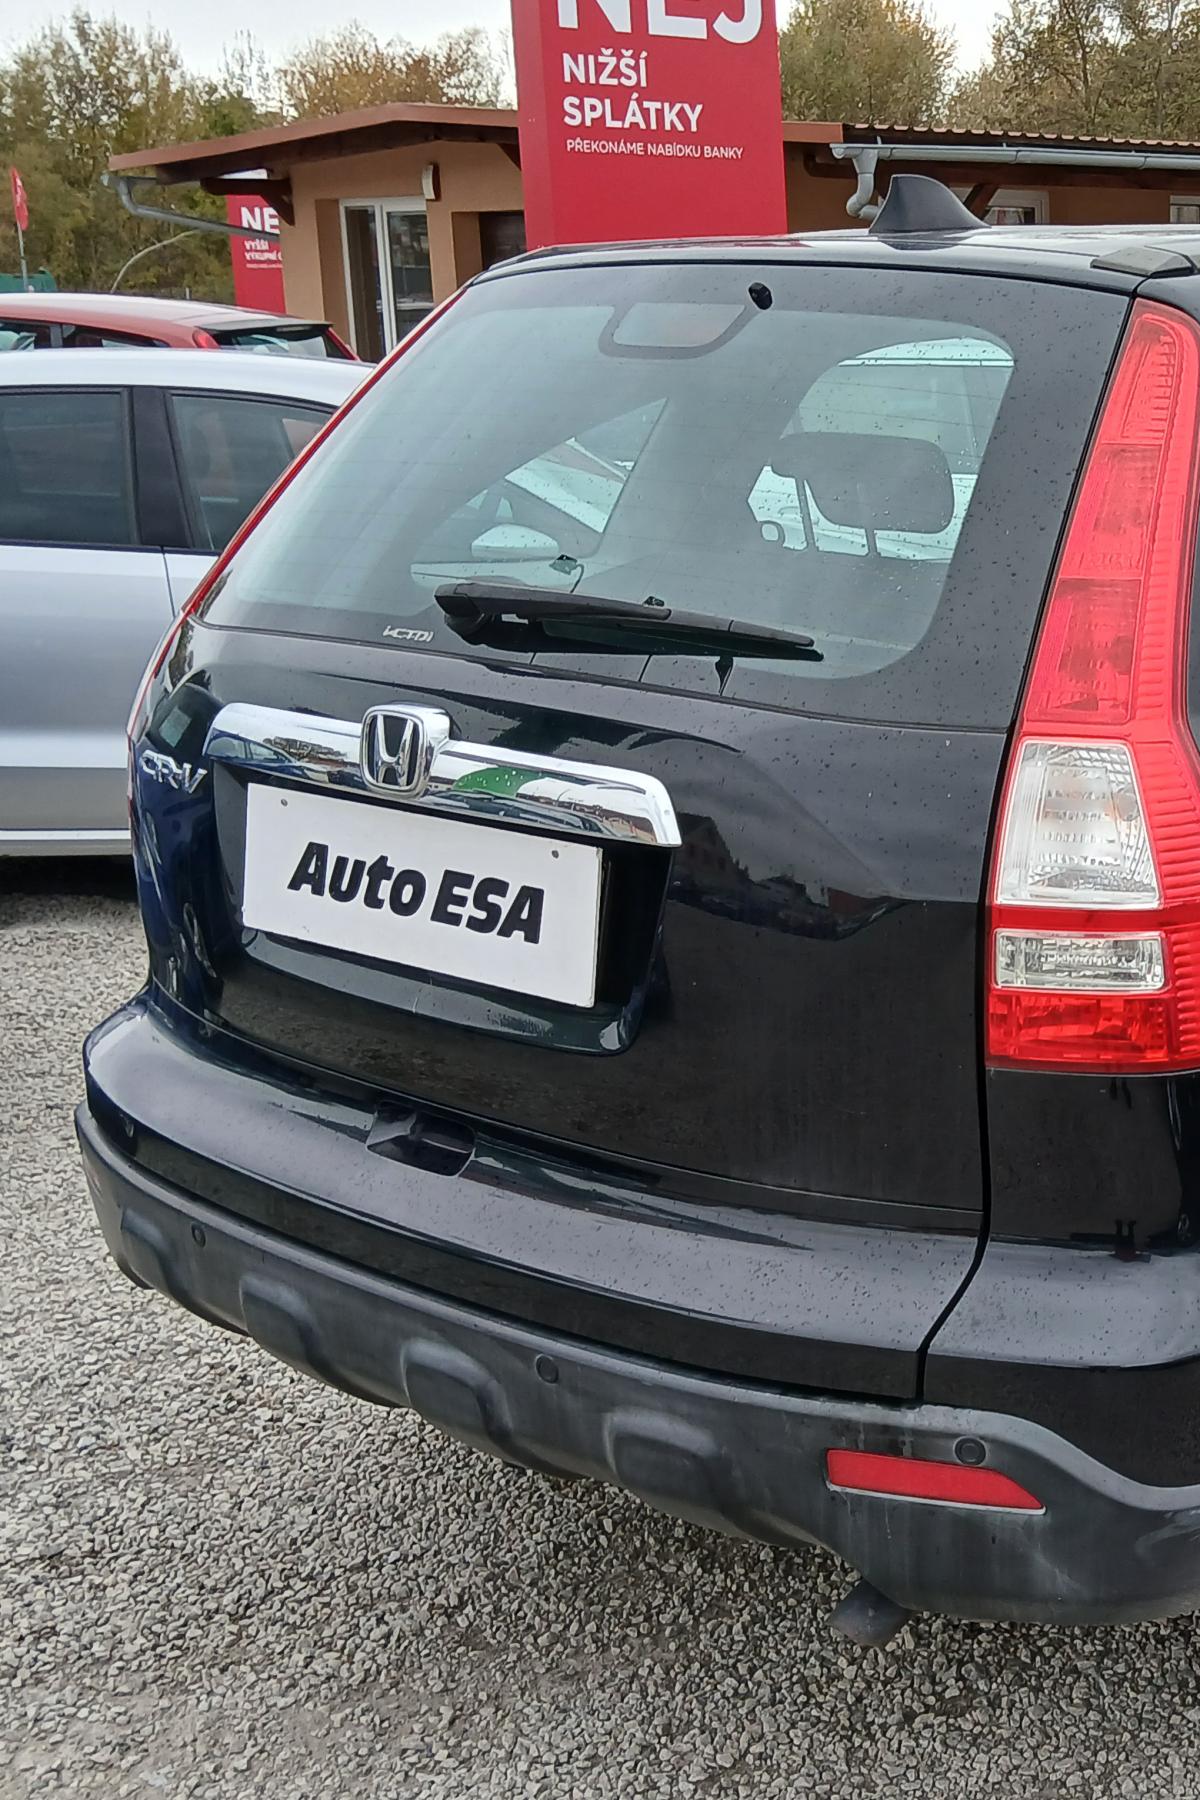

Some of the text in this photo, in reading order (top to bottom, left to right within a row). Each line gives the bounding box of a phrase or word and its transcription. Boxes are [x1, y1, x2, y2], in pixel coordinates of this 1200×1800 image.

[562, 47, 648, 88] NIŽŠÍ
[563, 92, 703, 132] SPLÁTKY
[566, 137, 744, 159] PŘEKONÁME NABÍDKU BANKY
[241, 206, 280, 235] NE
[139, 749, 208, 794] CR-V
[287, 841, 545, 945] Auto ESA
